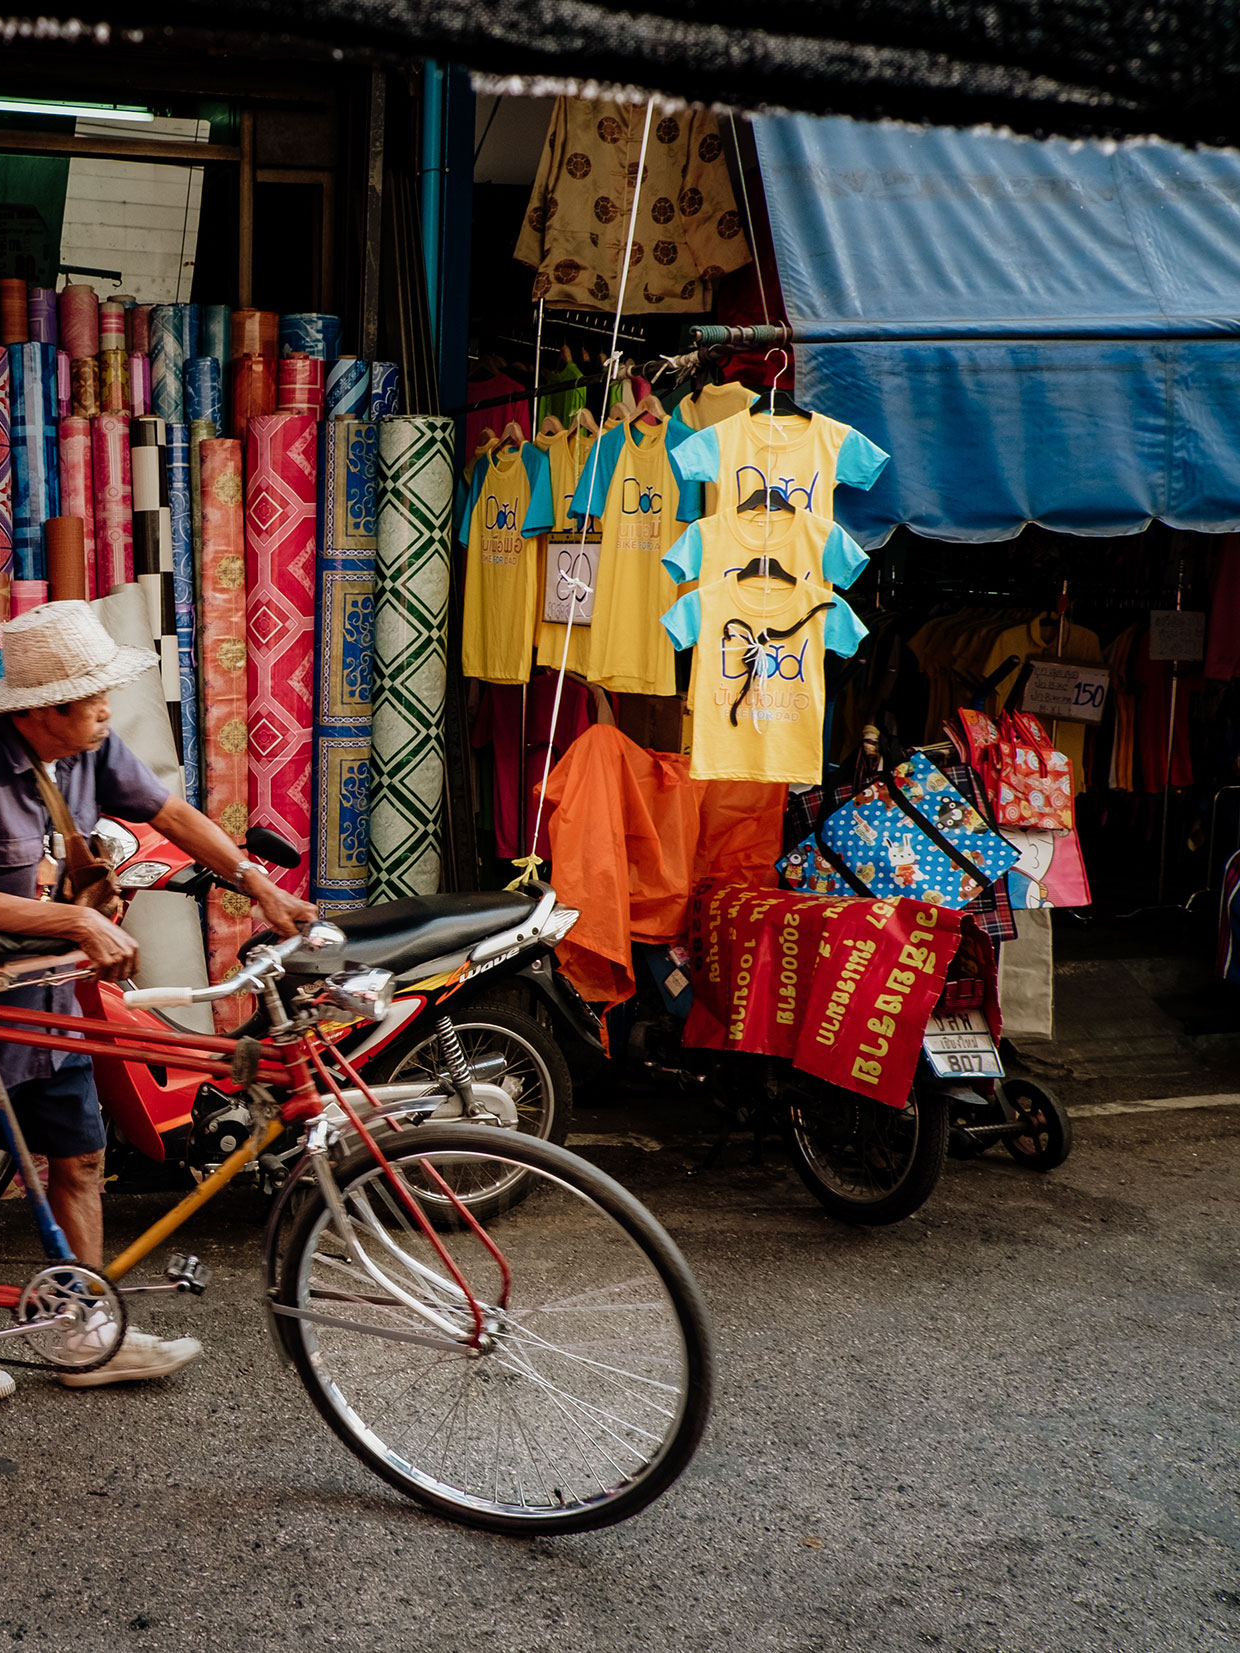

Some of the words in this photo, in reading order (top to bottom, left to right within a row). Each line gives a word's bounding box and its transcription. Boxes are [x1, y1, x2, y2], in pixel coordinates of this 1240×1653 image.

[556, 550, 592, 602] 80
[1072, 682, 1105, 708] 150
[947, 1055, 983, 1072] 807
